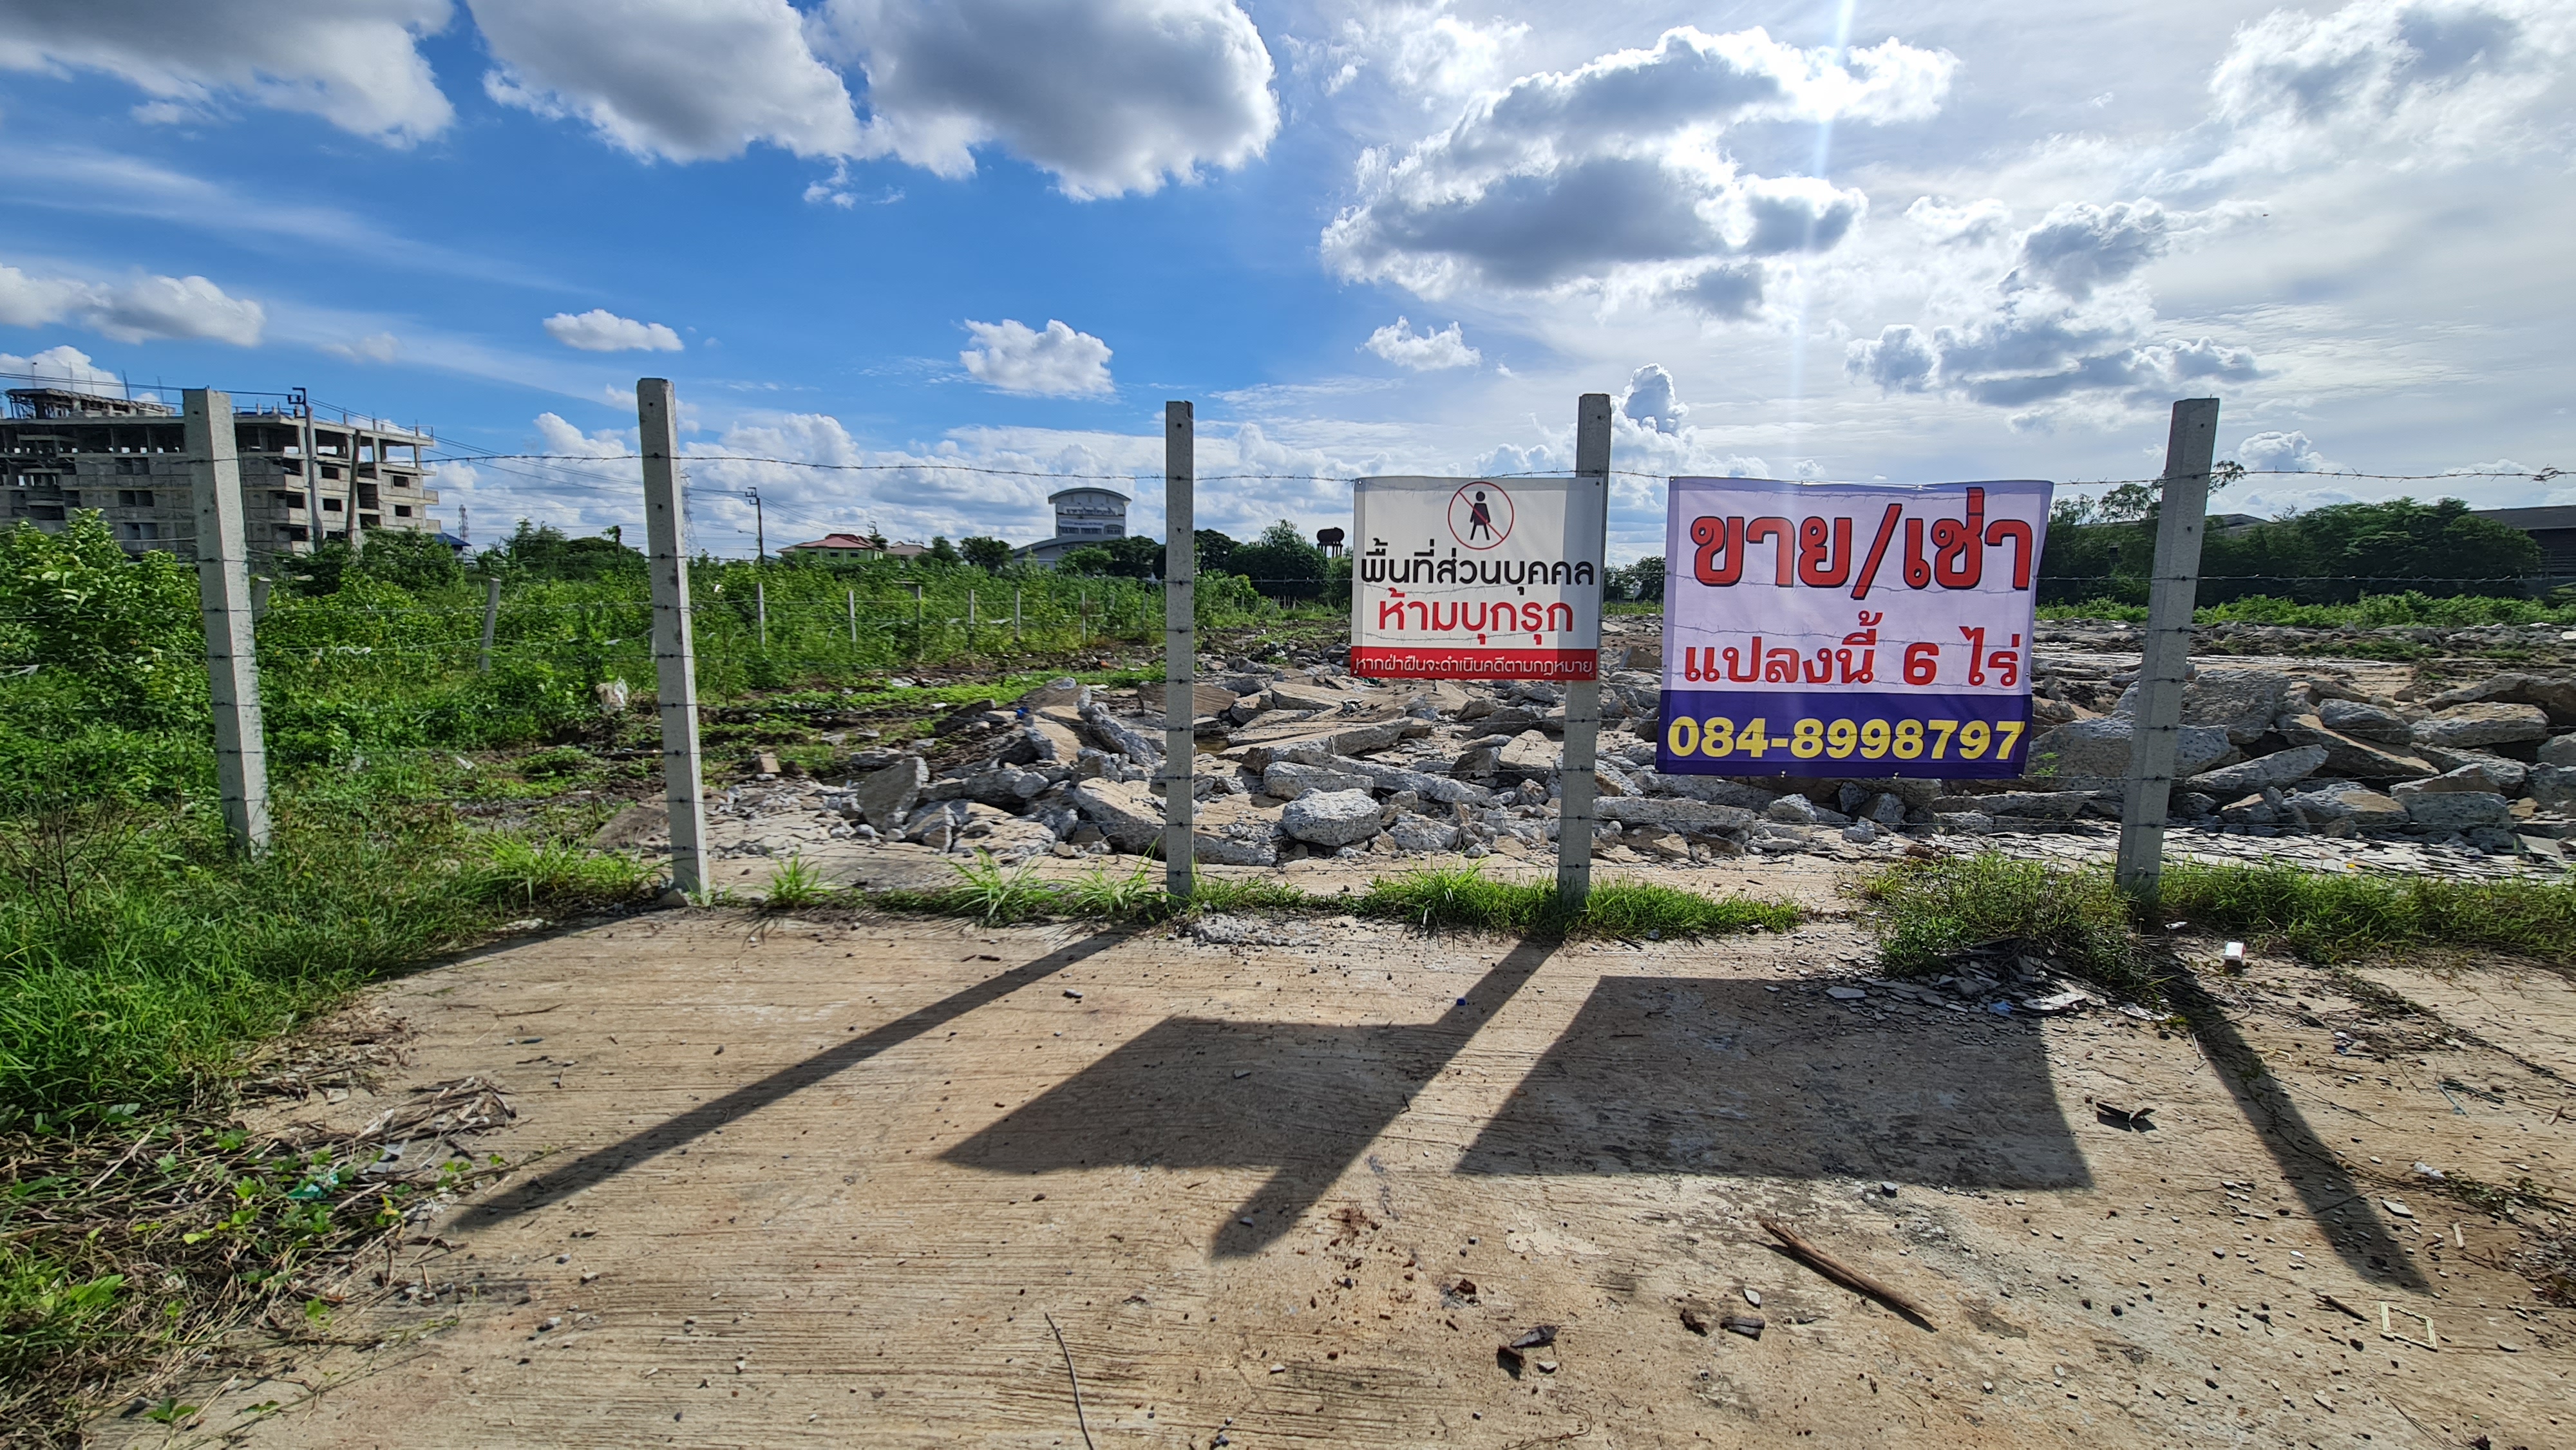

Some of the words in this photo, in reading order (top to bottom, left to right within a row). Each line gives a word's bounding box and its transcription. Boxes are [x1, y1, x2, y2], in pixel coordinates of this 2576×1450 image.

[1361, 538, 1594, 596] พื้นที่ส่วนบุคคล
[1689, 487, 2033, 600] ขาย/เช่า
[1379, 587, 1573, 645] ห้ามบุกรุก
[1356, 654, 1593, 676] หากฝ่าฝืนจะดำเนินคดีตามกฎหมาย
[1684, 610, 1883, 684] แปลงนี้
[1902, 642, 1939, 686] 6
[1958, 626, 2021, 687] ไร่
[1667, 716, 2026, 760] 084-8998797
